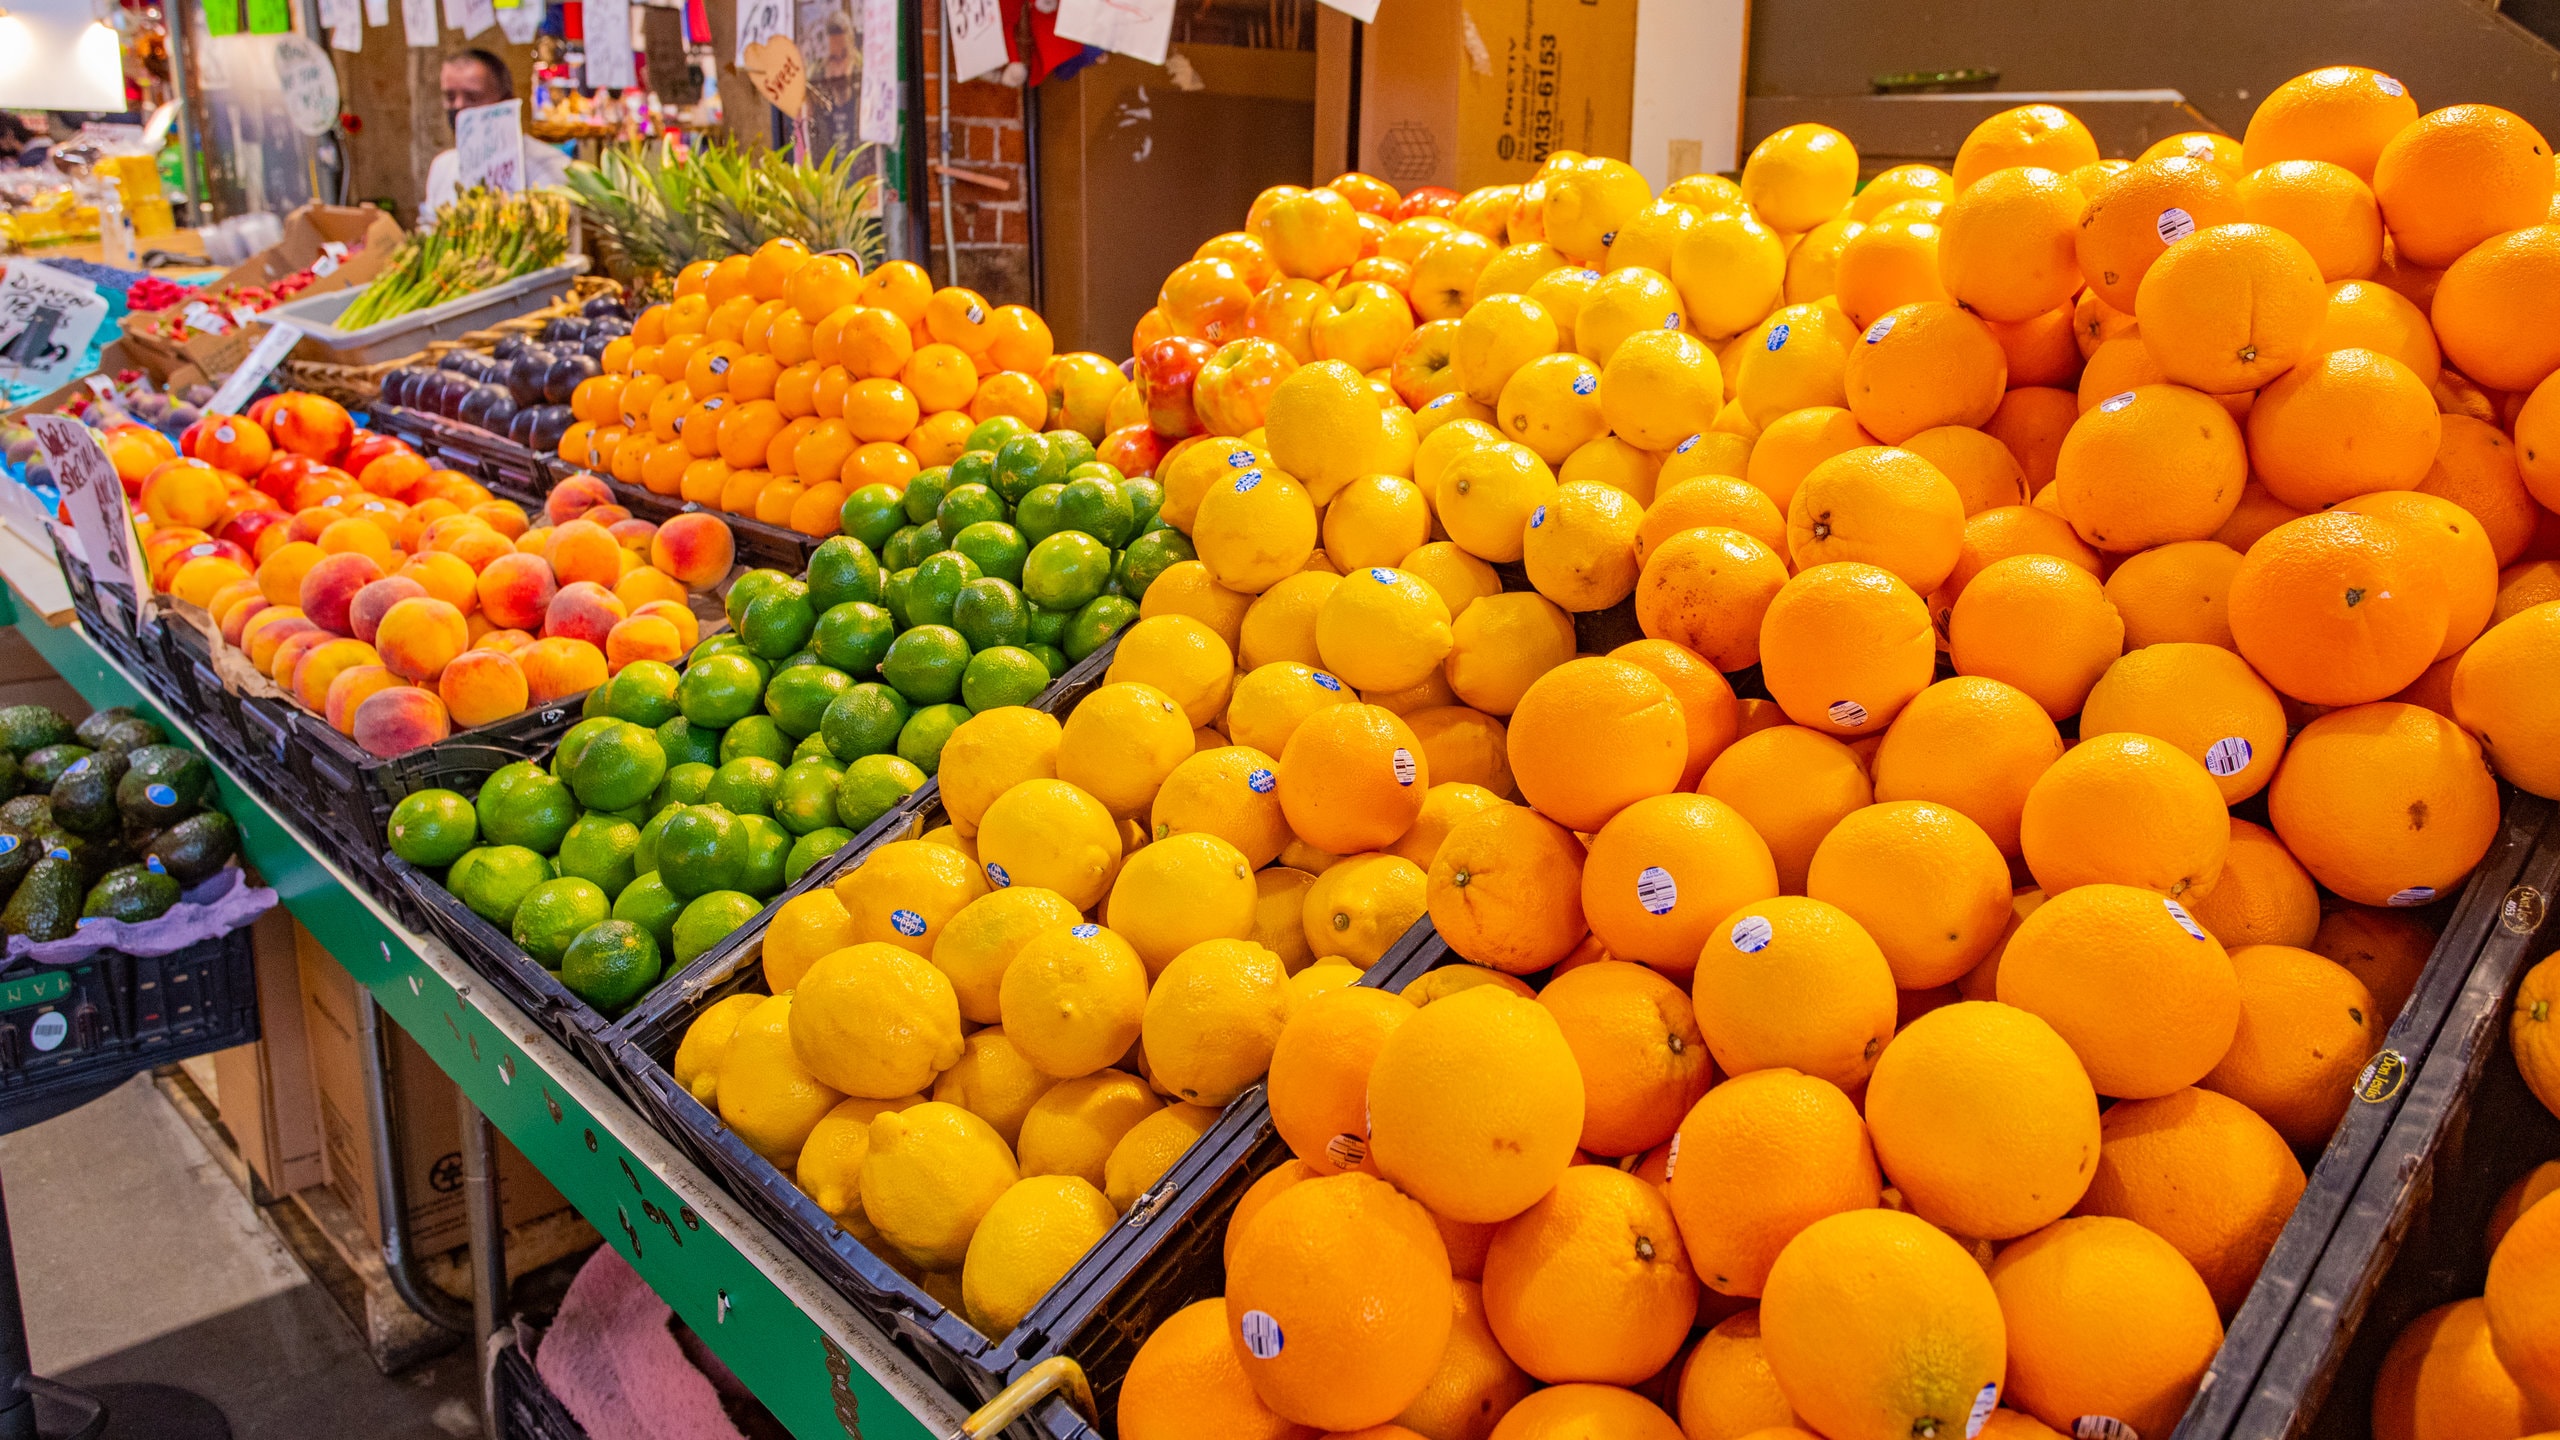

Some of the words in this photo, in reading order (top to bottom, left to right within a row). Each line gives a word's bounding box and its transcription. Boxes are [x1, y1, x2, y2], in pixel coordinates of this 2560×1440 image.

[764, 55, 800, 101] Sweet
[1534, 34, 1556, 163] M33-6153
[2504, 899, 2517, 916] 4053
[2377, 1056, 2398, 1076] Don
